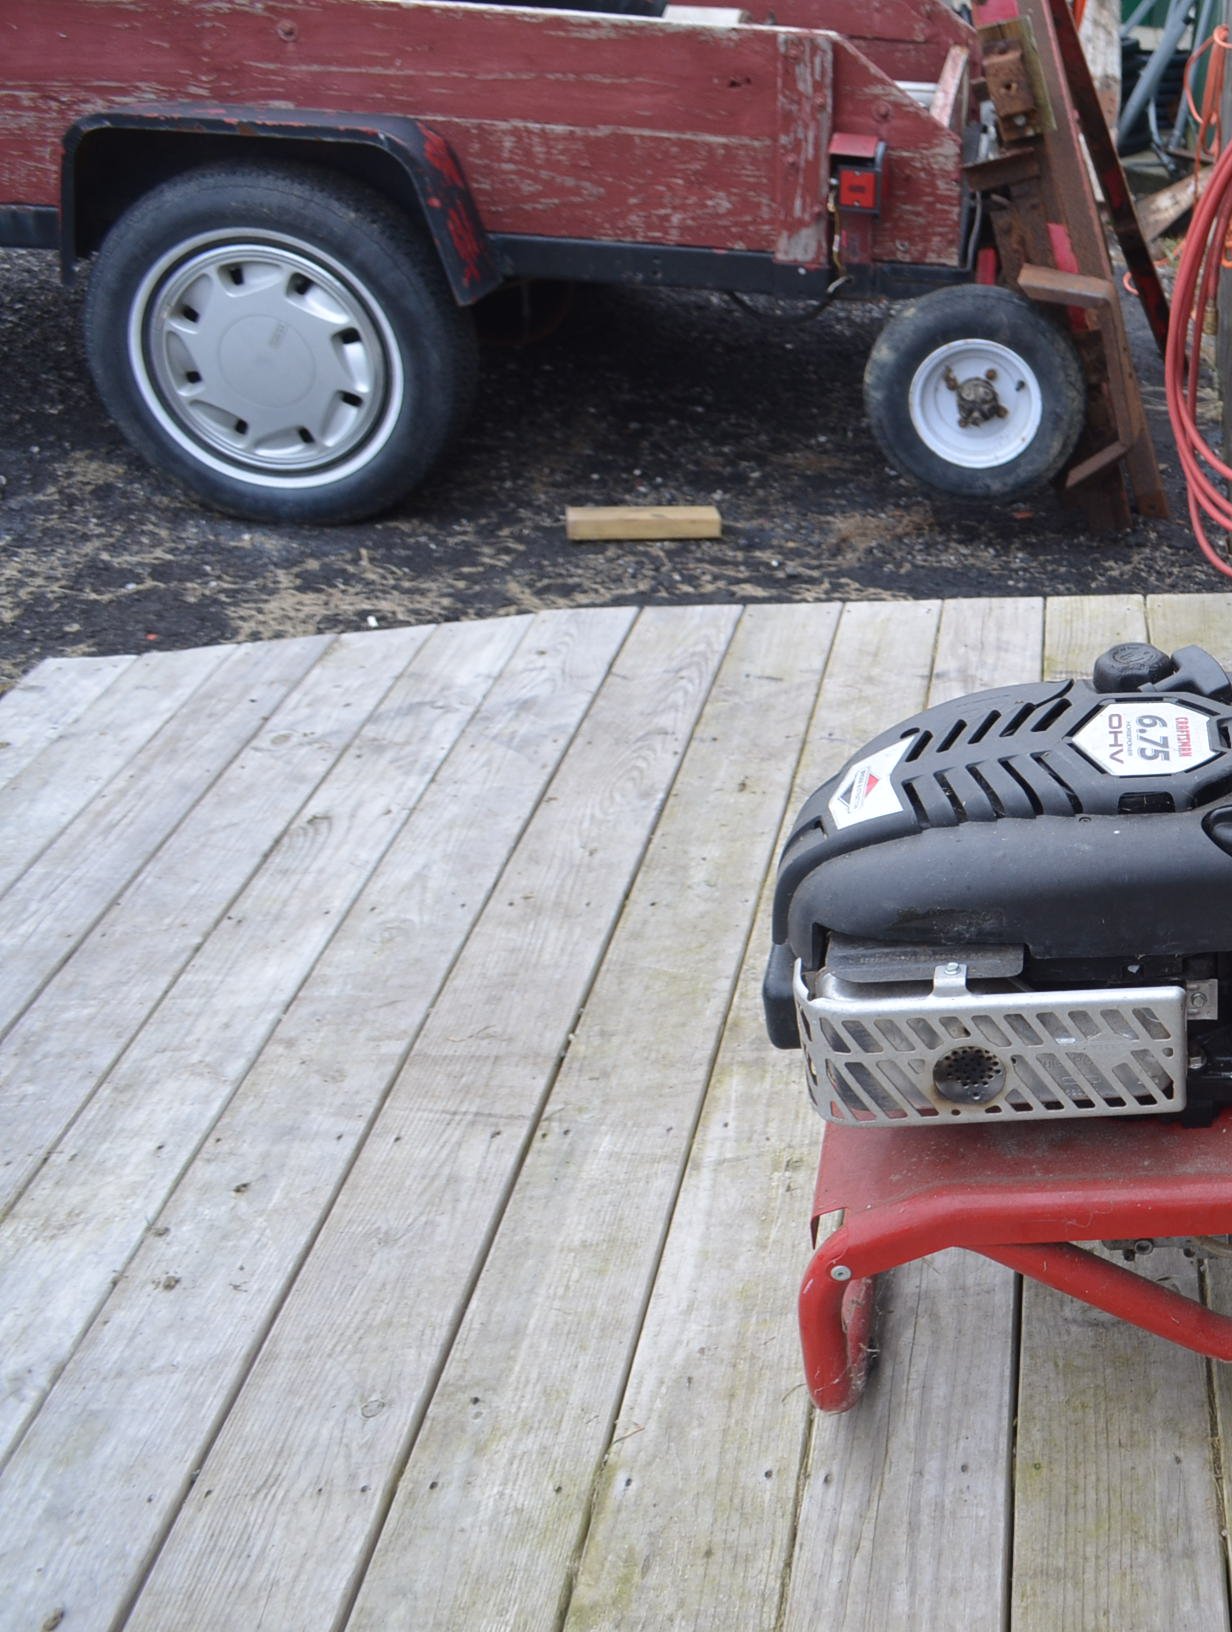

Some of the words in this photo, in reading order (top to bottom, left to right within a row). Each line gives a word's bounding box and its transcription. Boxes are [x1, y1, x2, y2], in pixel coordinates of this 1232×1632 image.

[1108, 713, 1125, 764] OHV
[1136, 714, 1171, 761] 6.75
[1175, 716, 1193, 757] CRAFTSMAN
